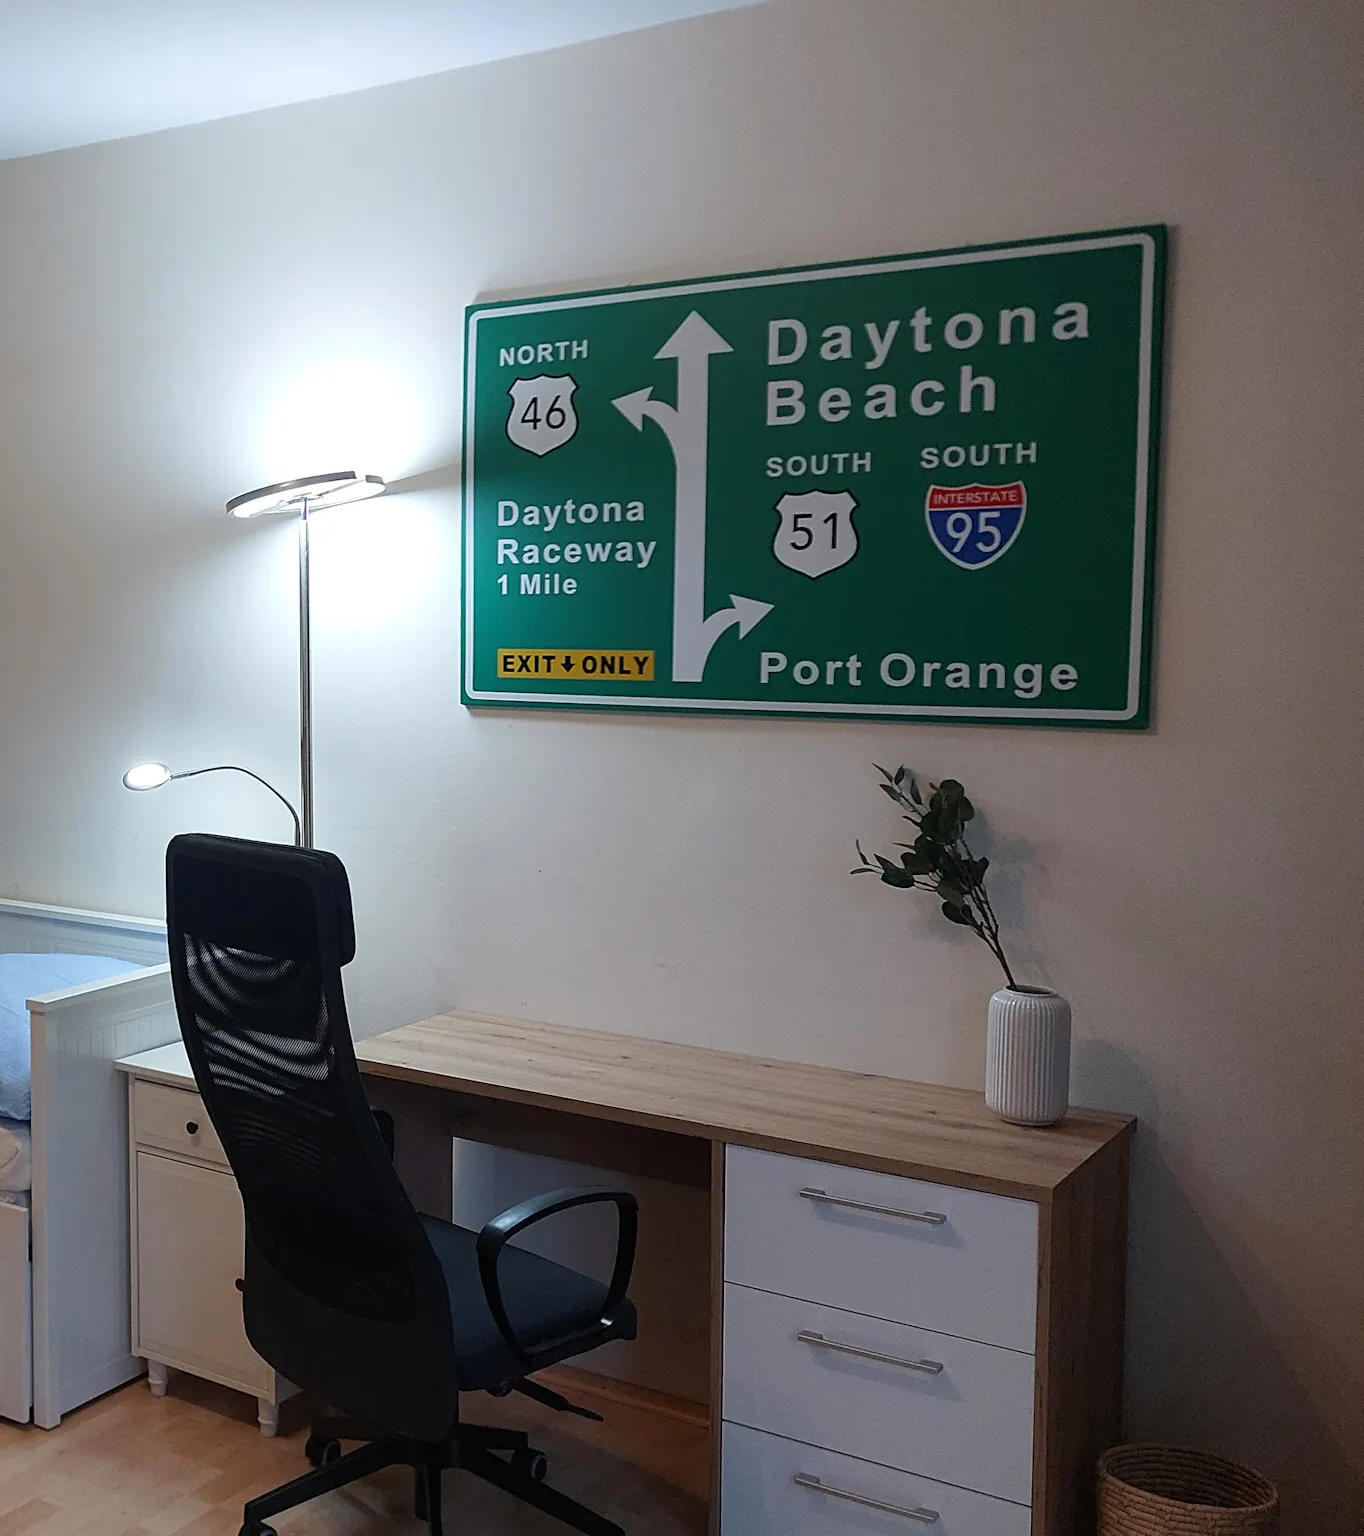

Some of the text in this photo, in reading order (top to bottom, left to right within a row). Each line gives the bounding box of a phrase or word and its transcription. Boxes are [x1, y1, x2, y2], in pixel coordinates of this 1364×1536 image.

[768, 302, 1088, 369] Daytona
[500, 340, 587, 366] NORTH
[767, 365, 995, 425] Beach
[521, 395, 565, 430] 46
[766, 452, 871, 477] SOUTH
[920, 442, 1036, 468] SOUTH
[933, 490, 1017, 505] INTERSTATE
[498, 500, 644, 531] Daytona
[791, 513, 837, 550] 51
[946, 511, 1002, 553] 95
[498, 539, 656, 568] Raceway
[498, 574, 577, 594] 1 Mile
[503, 655, 649, 674] EXIT ONLY
[760, 652, 1078, 698] Port Orange
